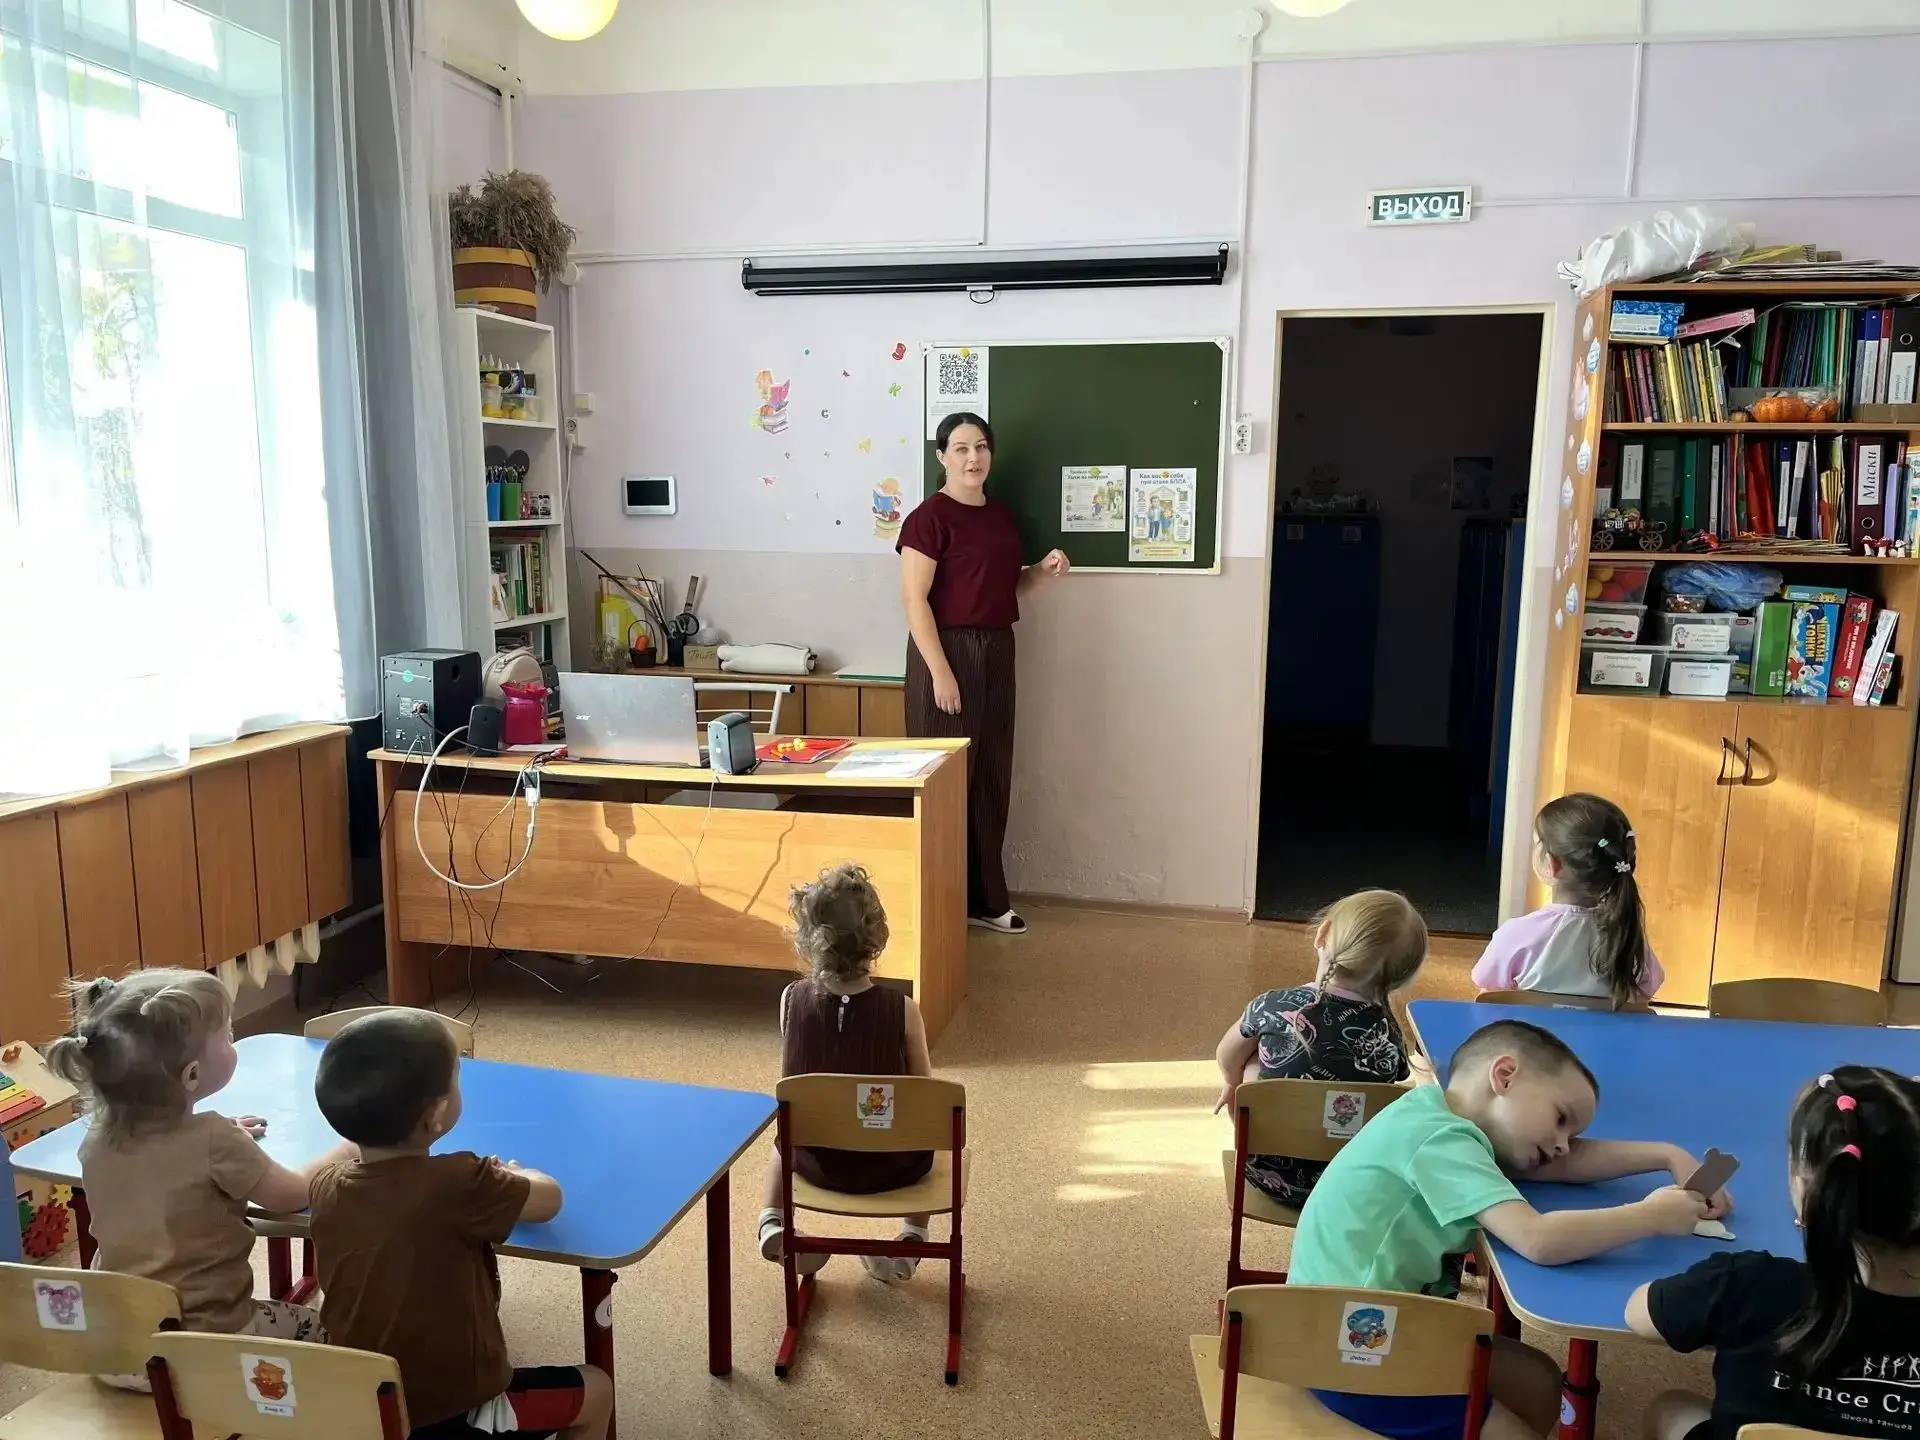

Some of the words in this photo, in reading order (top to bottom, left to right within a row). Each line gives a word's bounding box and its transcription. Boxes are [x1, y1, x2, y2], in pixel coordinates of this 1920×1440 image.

[1378, 194, 1460, 216] ВЫХОД
[1862, 451, 1877, 499] Маски
[1815, 616, 1829, 662] УШАСТЫЕ
[1840, 1412, 1874, 1425] Школа
[1877, 1419, 1913, 1431] танцев
